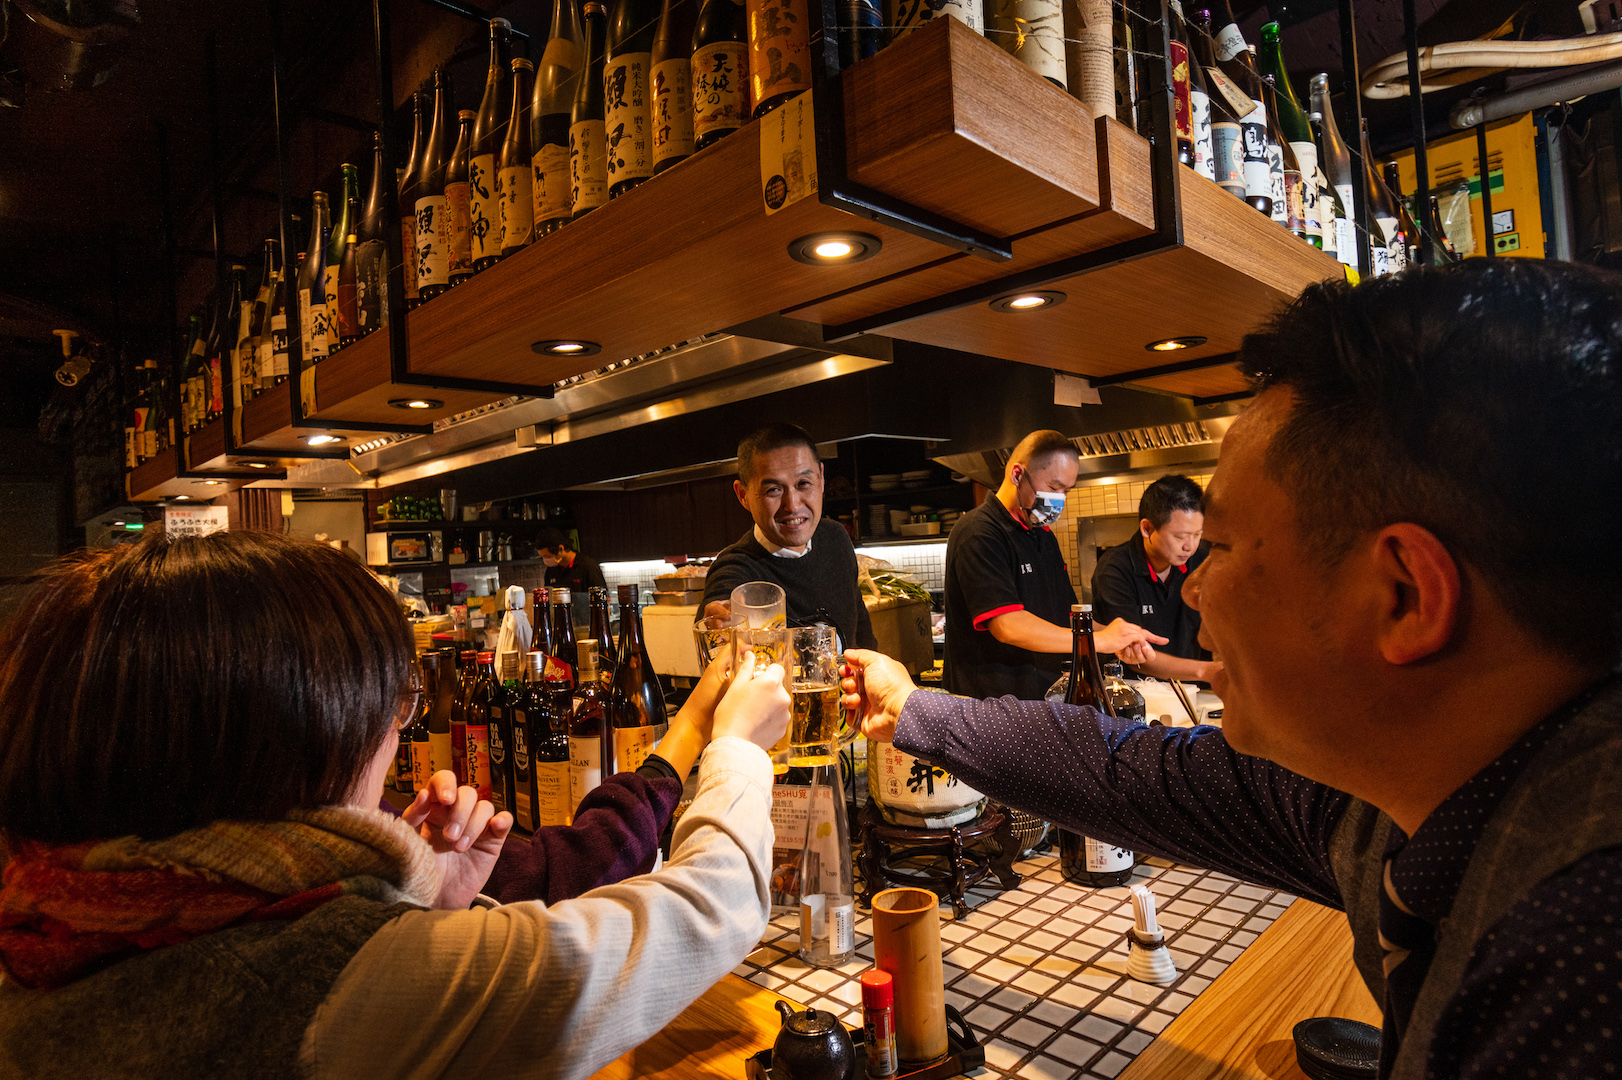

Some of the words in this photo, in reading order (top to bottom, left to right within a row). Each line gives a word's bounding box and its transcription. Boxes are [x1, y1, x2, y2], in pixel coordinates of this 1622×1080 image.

[631, 62, 643, 107] 純米大吟醸
[633, 115, 646, 167] 磨き二割三分
